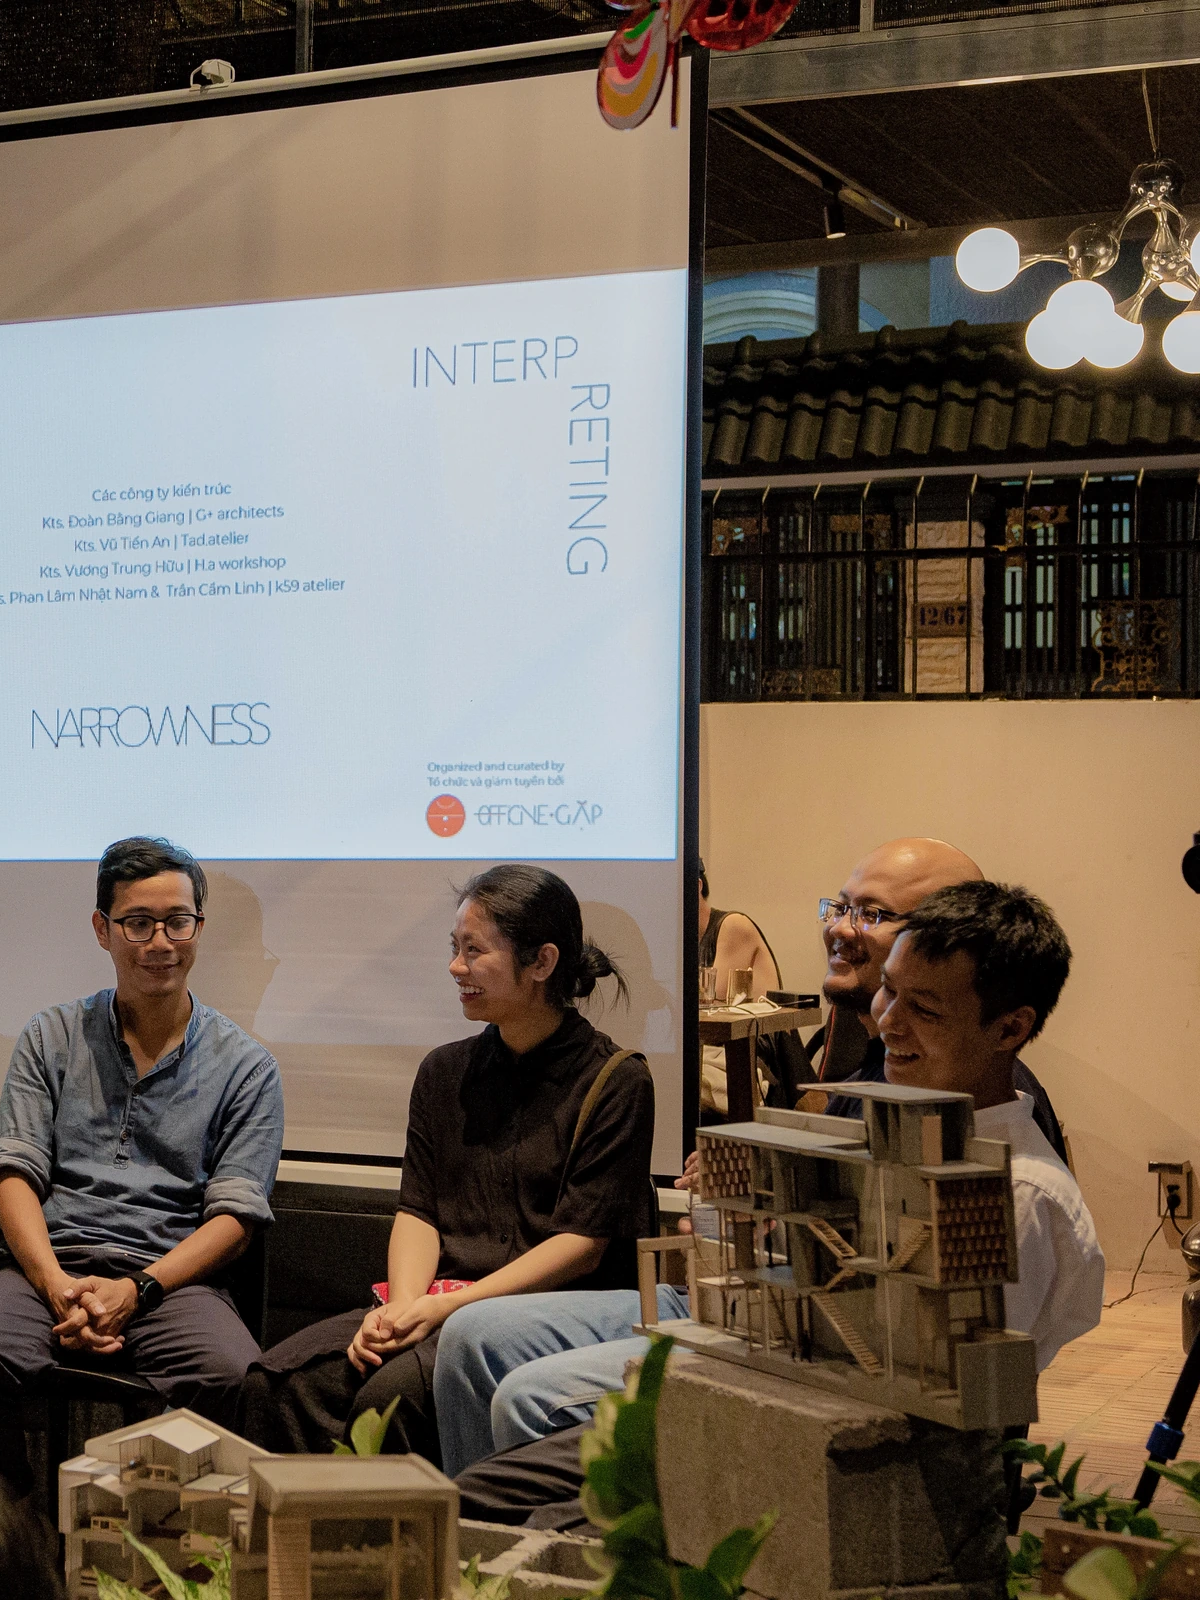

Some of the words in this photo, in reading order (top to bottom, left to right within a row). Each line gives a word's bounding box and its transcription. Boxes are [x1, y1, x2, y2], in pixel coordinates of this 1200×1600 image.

[411, 335, 578, 388] INTERP
[566, 383, 610, 575] RETING
[92, 489, 116, 501] Các
[119, 487, 153, 502] công
[157, 487, 169, 501] ty
[173, 482, 201, 497] kiến
[204, 481, 232, 496] trúc
[68, 514, 103, 528] Đoàn
[145, 509, 185, 526] Giang
[195, 508, 213, 522] G+
[217, 506, 285, 521] architects
[100, 538, 118, 551] Vũ
[120, 536, 149, 550] Tiến
[151, 536, 170, 548] An
[181, 531, 249, 547] Tad.atelier
[111, 561, 152, 577] Trung
[219, 555, 287, 571] workshop
[10, 591, 44, 604] Phan
[47, 589, 75, 603] Lâm
[79, 588, 110, 604] Nhật
[115, 586, 147, 600] Nam
[150, 585, 160, 598] &
[235, 580, 265, 595] Linh
[275, 579, 300, 593] k59
[302, 578, 345, 592] atelier
[31, 702, 271, 749] NARROWNESS
[427, 761, 482, 774] Organized
[484, 761, 505, 771] and
[506, 760, 549, 771] curated
[551, 760, 565, 773] by
